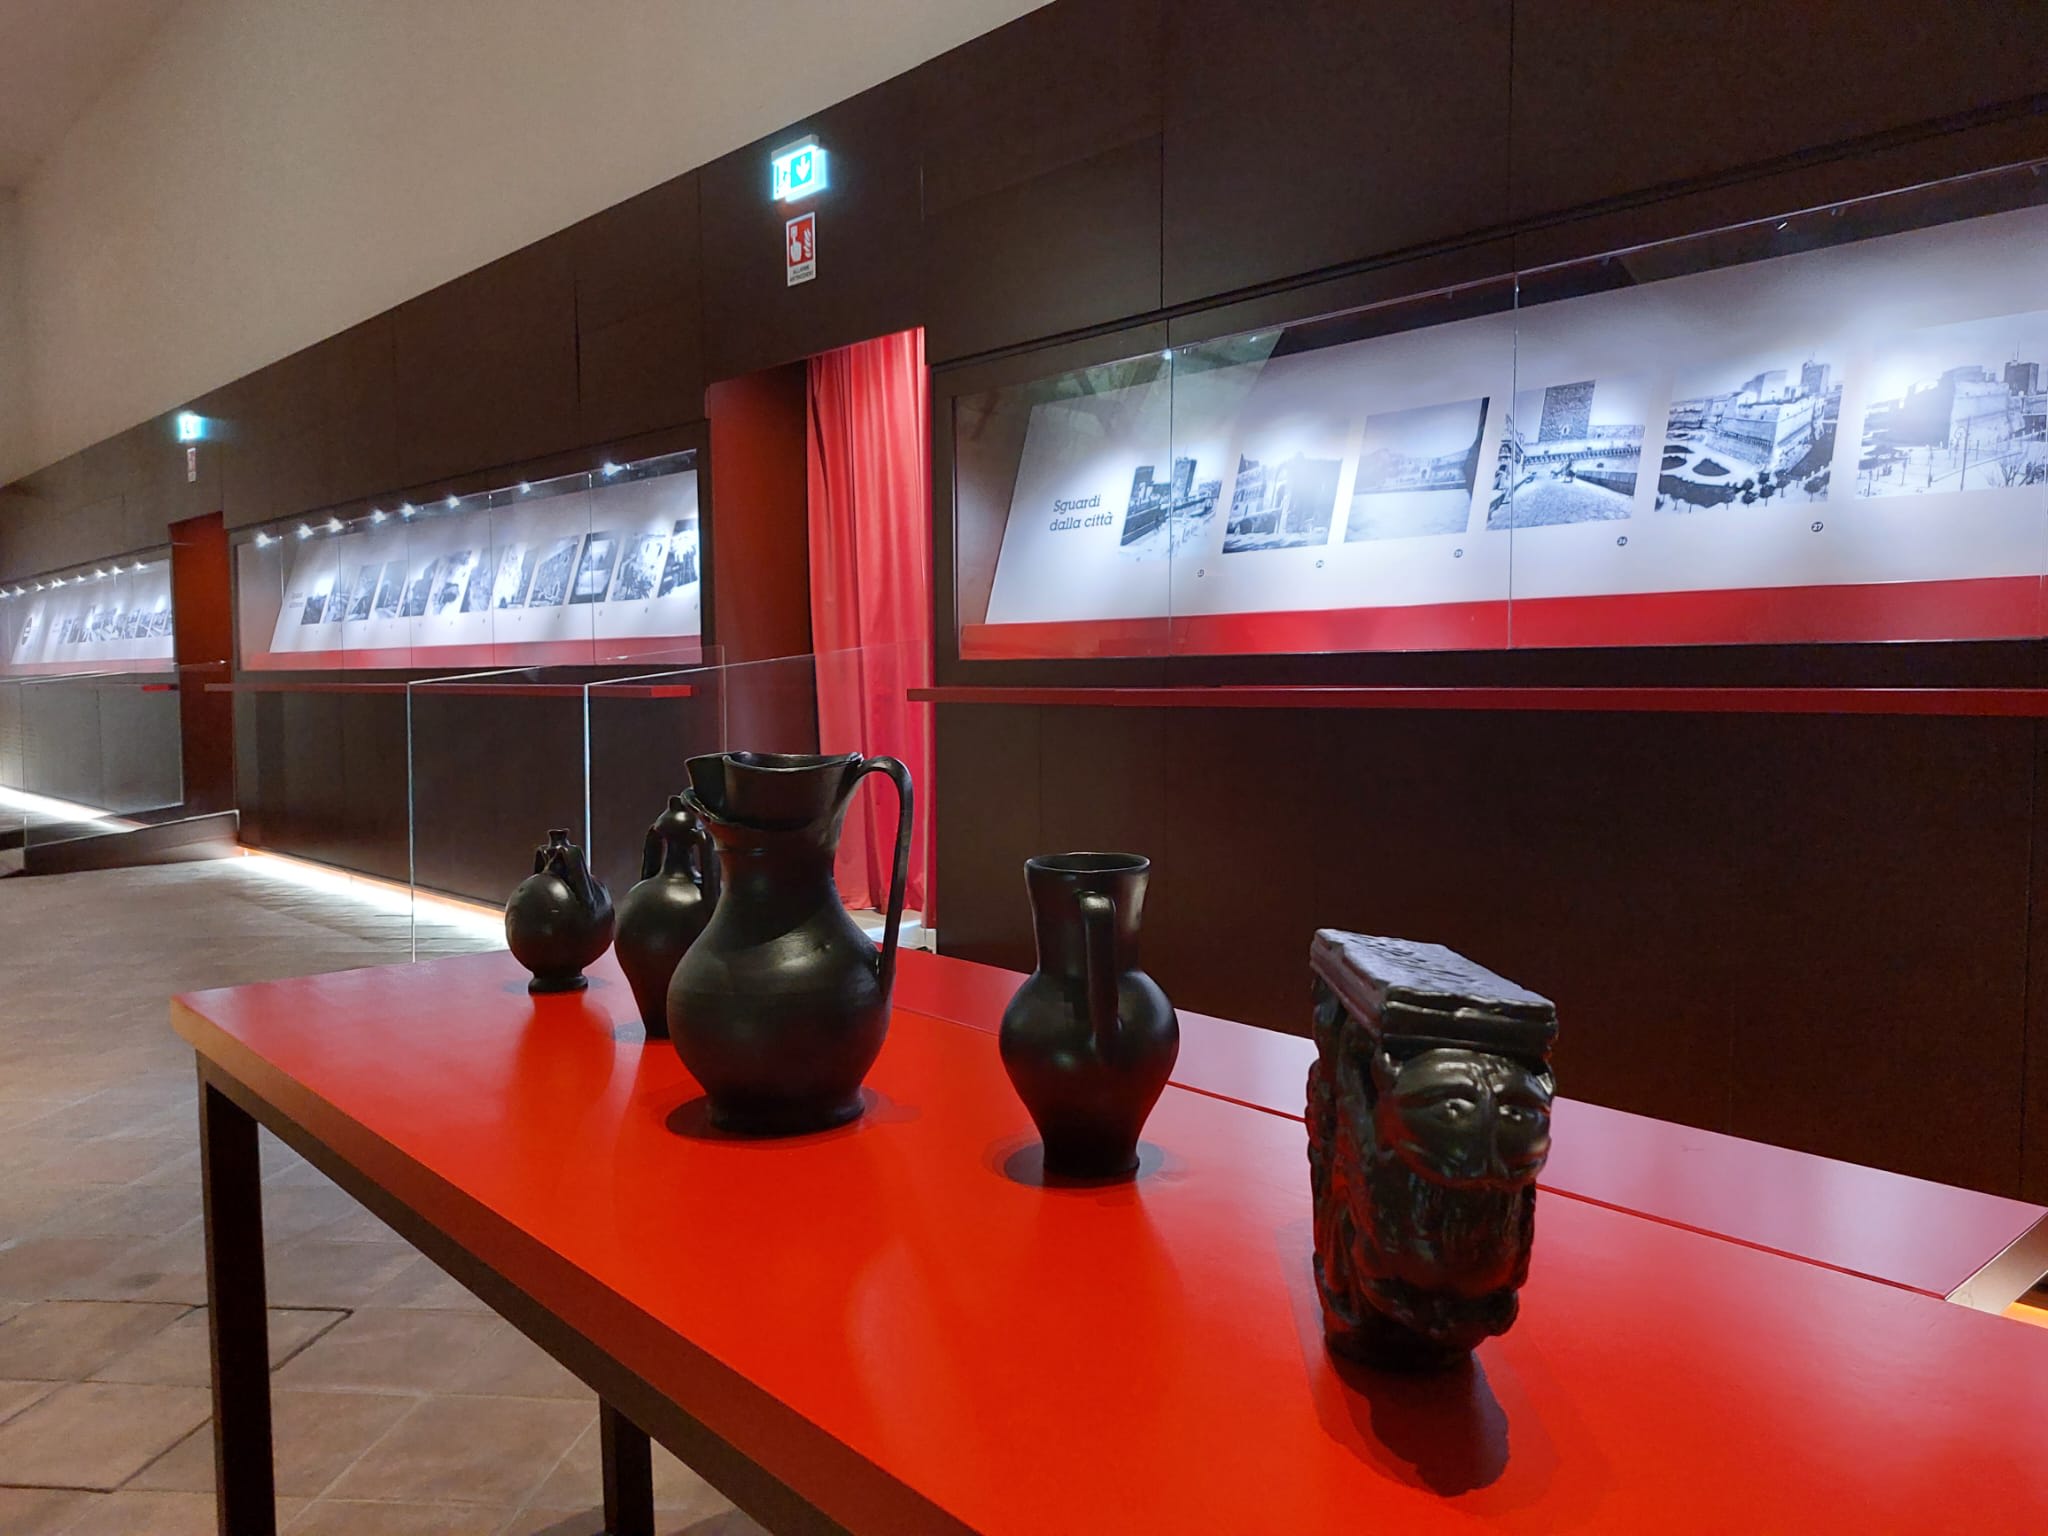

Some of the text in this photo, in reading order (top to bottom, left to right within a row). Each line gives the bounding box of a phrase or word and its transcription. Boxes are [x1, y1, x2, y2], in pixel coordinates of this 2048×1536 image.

[1053, 495, 1101, 514] Sguardi
[1050, 512, 1113, 531] dalla città
